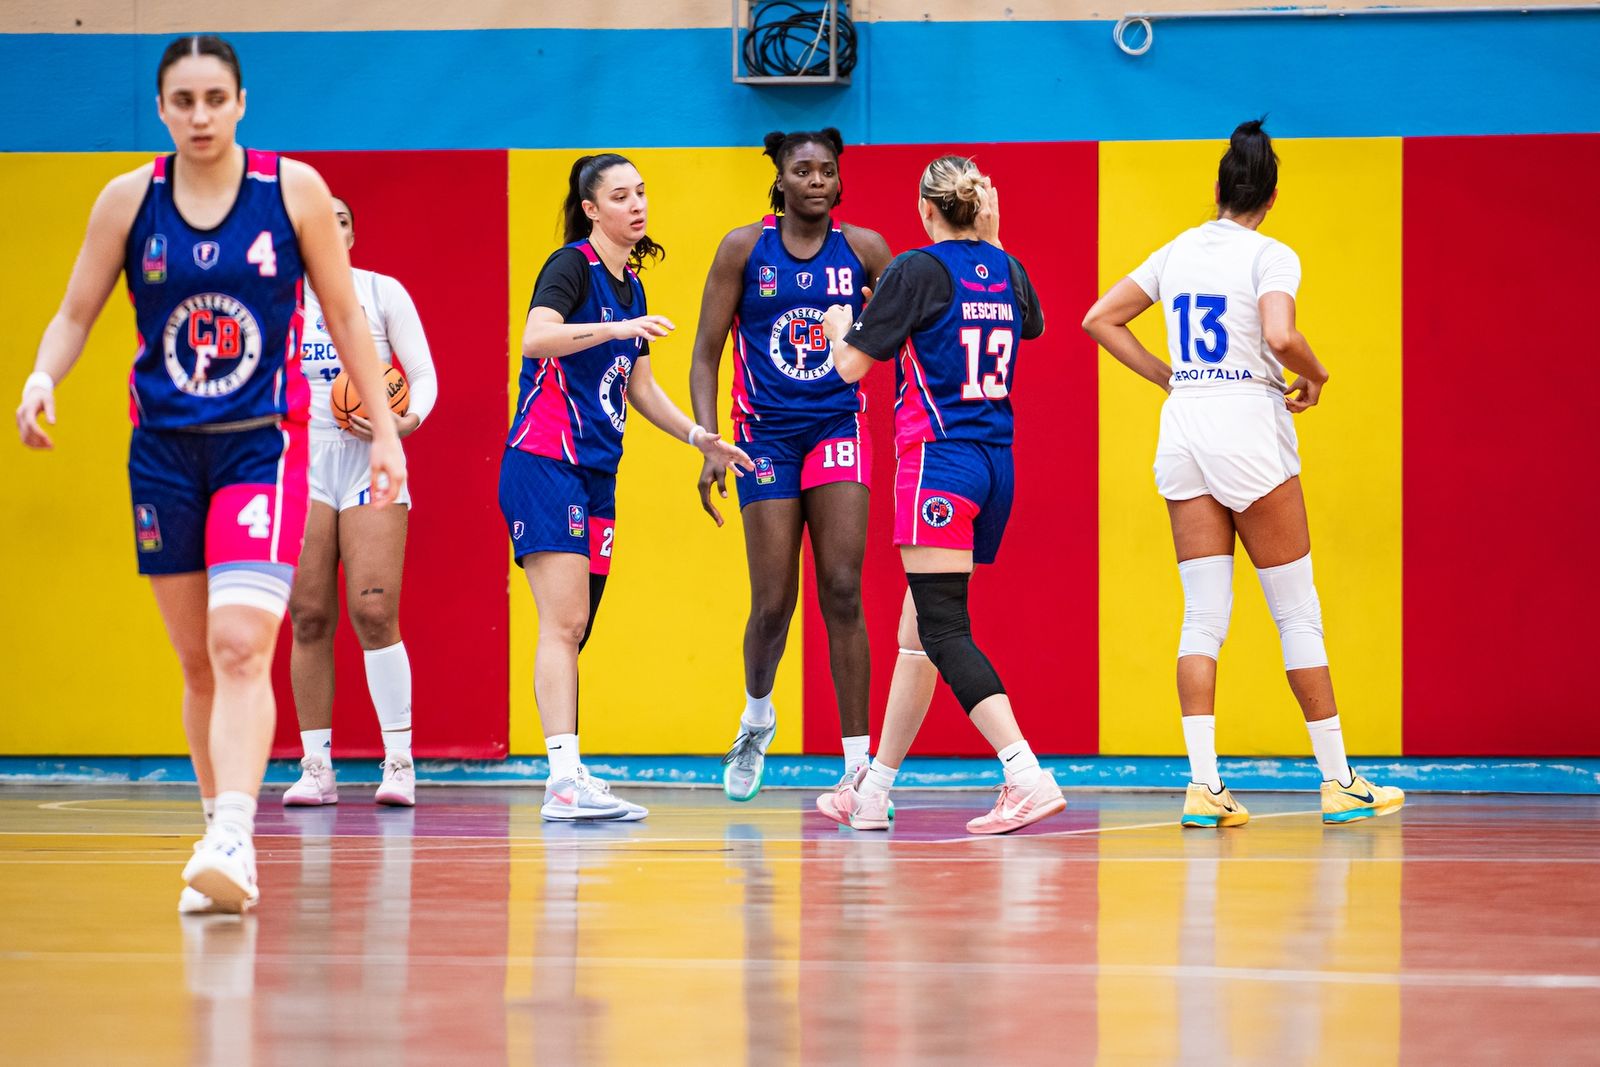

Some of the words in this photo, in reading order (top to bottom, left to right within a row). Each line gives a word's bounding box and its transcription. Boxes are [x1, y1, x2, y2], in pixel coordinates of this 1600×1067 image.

[246, 231, 277, 276] 4
[825, 267, 853, 296] 18
[961, 302, 1014, 321] RESCIFINA
[1172, 293, 1229, 364] 13
[780, 362, 832, 380] ACADEMY
[960, 326, 1014, 401] 13
[1174, 368, 1253, 382] EROITALIA
[823, 440, 856, 468] 18
[237, 493, 271, 538] 4
[599, 527, 614, 557] 2
